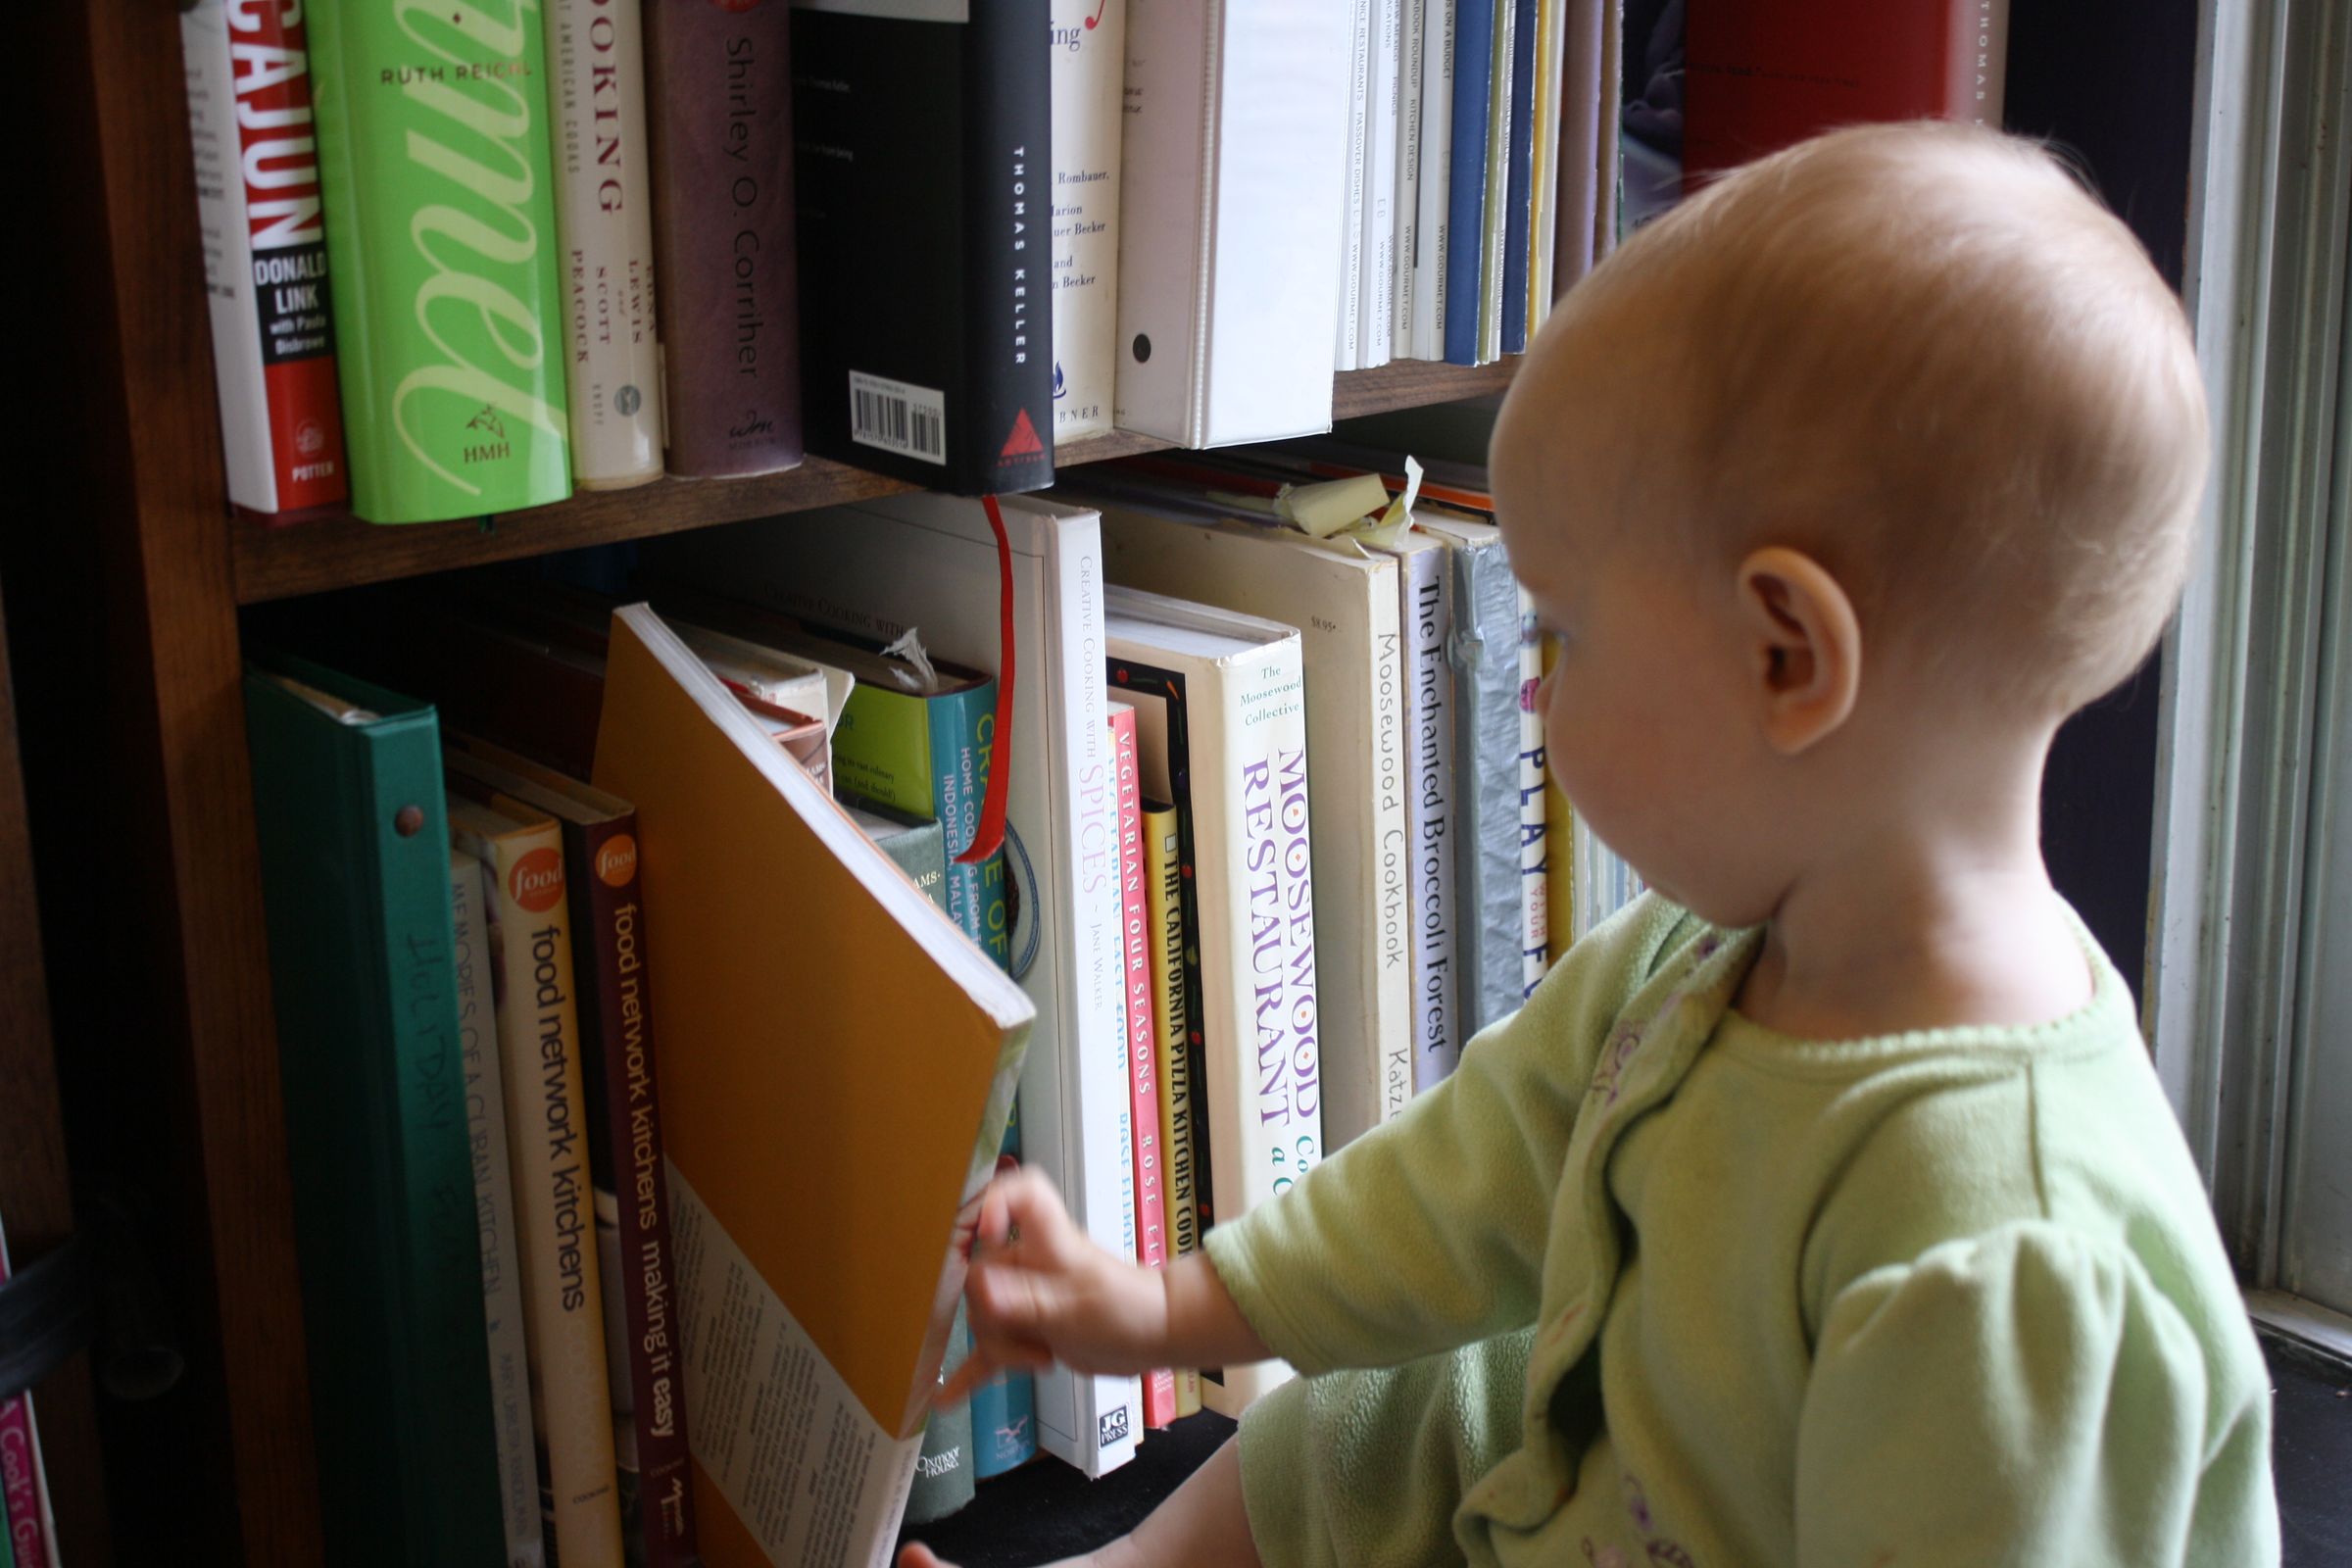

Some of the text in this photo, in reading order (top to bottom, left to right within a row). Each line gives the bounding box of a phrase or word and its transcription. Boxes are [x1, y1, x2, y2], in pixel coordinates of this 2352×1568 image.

[1444, 11, 1452, 27] ON
[1975, 0, 1990, 101] THOMAS
[380, 60, 532, 85] RUTH REICHL
[560, 23, 577, 110] AMERICAN
[1355, 26, 1367, 102] RESTAURANTS
[1409, 37, 1421, 89] ROUNDUP
[1442, 38, 1452, 81] BUDGET
[224, 0, 324, 251] CAJUN
[565, 120, 581, 174] COOKS
[1353, 111, 1365, 166] PASSOVER
[1406, 98, 1419, 142] KITCHEN
[1351, 168, 1363, 206] DISHES
[1405, 144, 1417, 182] DESIGN
[724, 37, 764, 379] Shirley O. Corriher
[1074, 221, 1106, 237] Becker
[255, 252, 326, 286] DONALD
[1012, 145, 1027, 366] THOMAS KELLER
[1054, 254, 1074, 270] and
[1062, 273, 1097, 290] Becker
[1400, 225, 1413, 331] WWW.GOURMET.COM
[1435, 224, 1448, 331] WWW.GOURMET.COM
[274, 286, 319, 316] LINK
[570, 249, 589, 365] PEACOCK
[595, 266, 612, 346] SCOTT
[627, 259, 643, 345] LEWIS
[1348, 243, 1361, 352] WWW.GOURMET.COM
[1375, 239, 1387, 348] WWW.GOURMET.COM
[291, 461, 335, 483] POTTER
[464, 441, 512, 464] HMH
[1239, 676, 1302, 708] Moosewood
[1260, 665, 1282, 681] The
[1245, 704, 1300, 727] Collective
[1377, 632, 1399, 812] Moosewood
[959, 747, 976, 796] HOME
[1078, 555, 1108, 1010] CREATIVE COOKING WITH SPICES JANE WALKER
[1118, 730, 1140, 892] VEGETARIAN
[1419, 575, 1452, 1053] The Enchanted Broccoli Forest
[1520, 747, 1547, 876] PLAY
[514, 858, 564, 902] food
[601, 842, 637, 879] food
[1163, 860, 1182, 896] THE
[967, 883, 982, 930] FROM
[986, 896, 1007, 957] OF
[1277, 746, 1319, 1119] MOOSEWOOD
[1383, 829, 1407, 969] Cookbook
[1530, 888, 1540, 940] YOUR
[532, 924, 565, 1005] food
[613, 903, 639, 972] food
[1128, 905, 1146, 976] FOUR
[1166, 898, 1185, 1038] CALIFORNIA
[1242, 754, 1291, 1127] RESTAURANT
[1271, 1147, 1286, 1167] a
[619, 980, 652, 1103] network
[1133, 981, 1152, 1095] SEASONS
[1170, 1039, 1188, 1105] PIZZA
[538, 1014, 577, 1160] network
[630, 1105, 658, 1232] kitchens
[1142, 1135, 1157, 1205] ROSE
[1173, 1104, 1193, 1201] KITCHEN
[553, 1164, 587, 1313] kitchens
[643, 1241, 670, 1354] making
[650, 1355, 673, 1376] it
[651, 1378, 676, 1439] easy
[1101, 1409, 1126, 1433] JG
[1101, 1424, 1128, 1446] PRESS
[0, 1426, 33, 1512] Cook's
